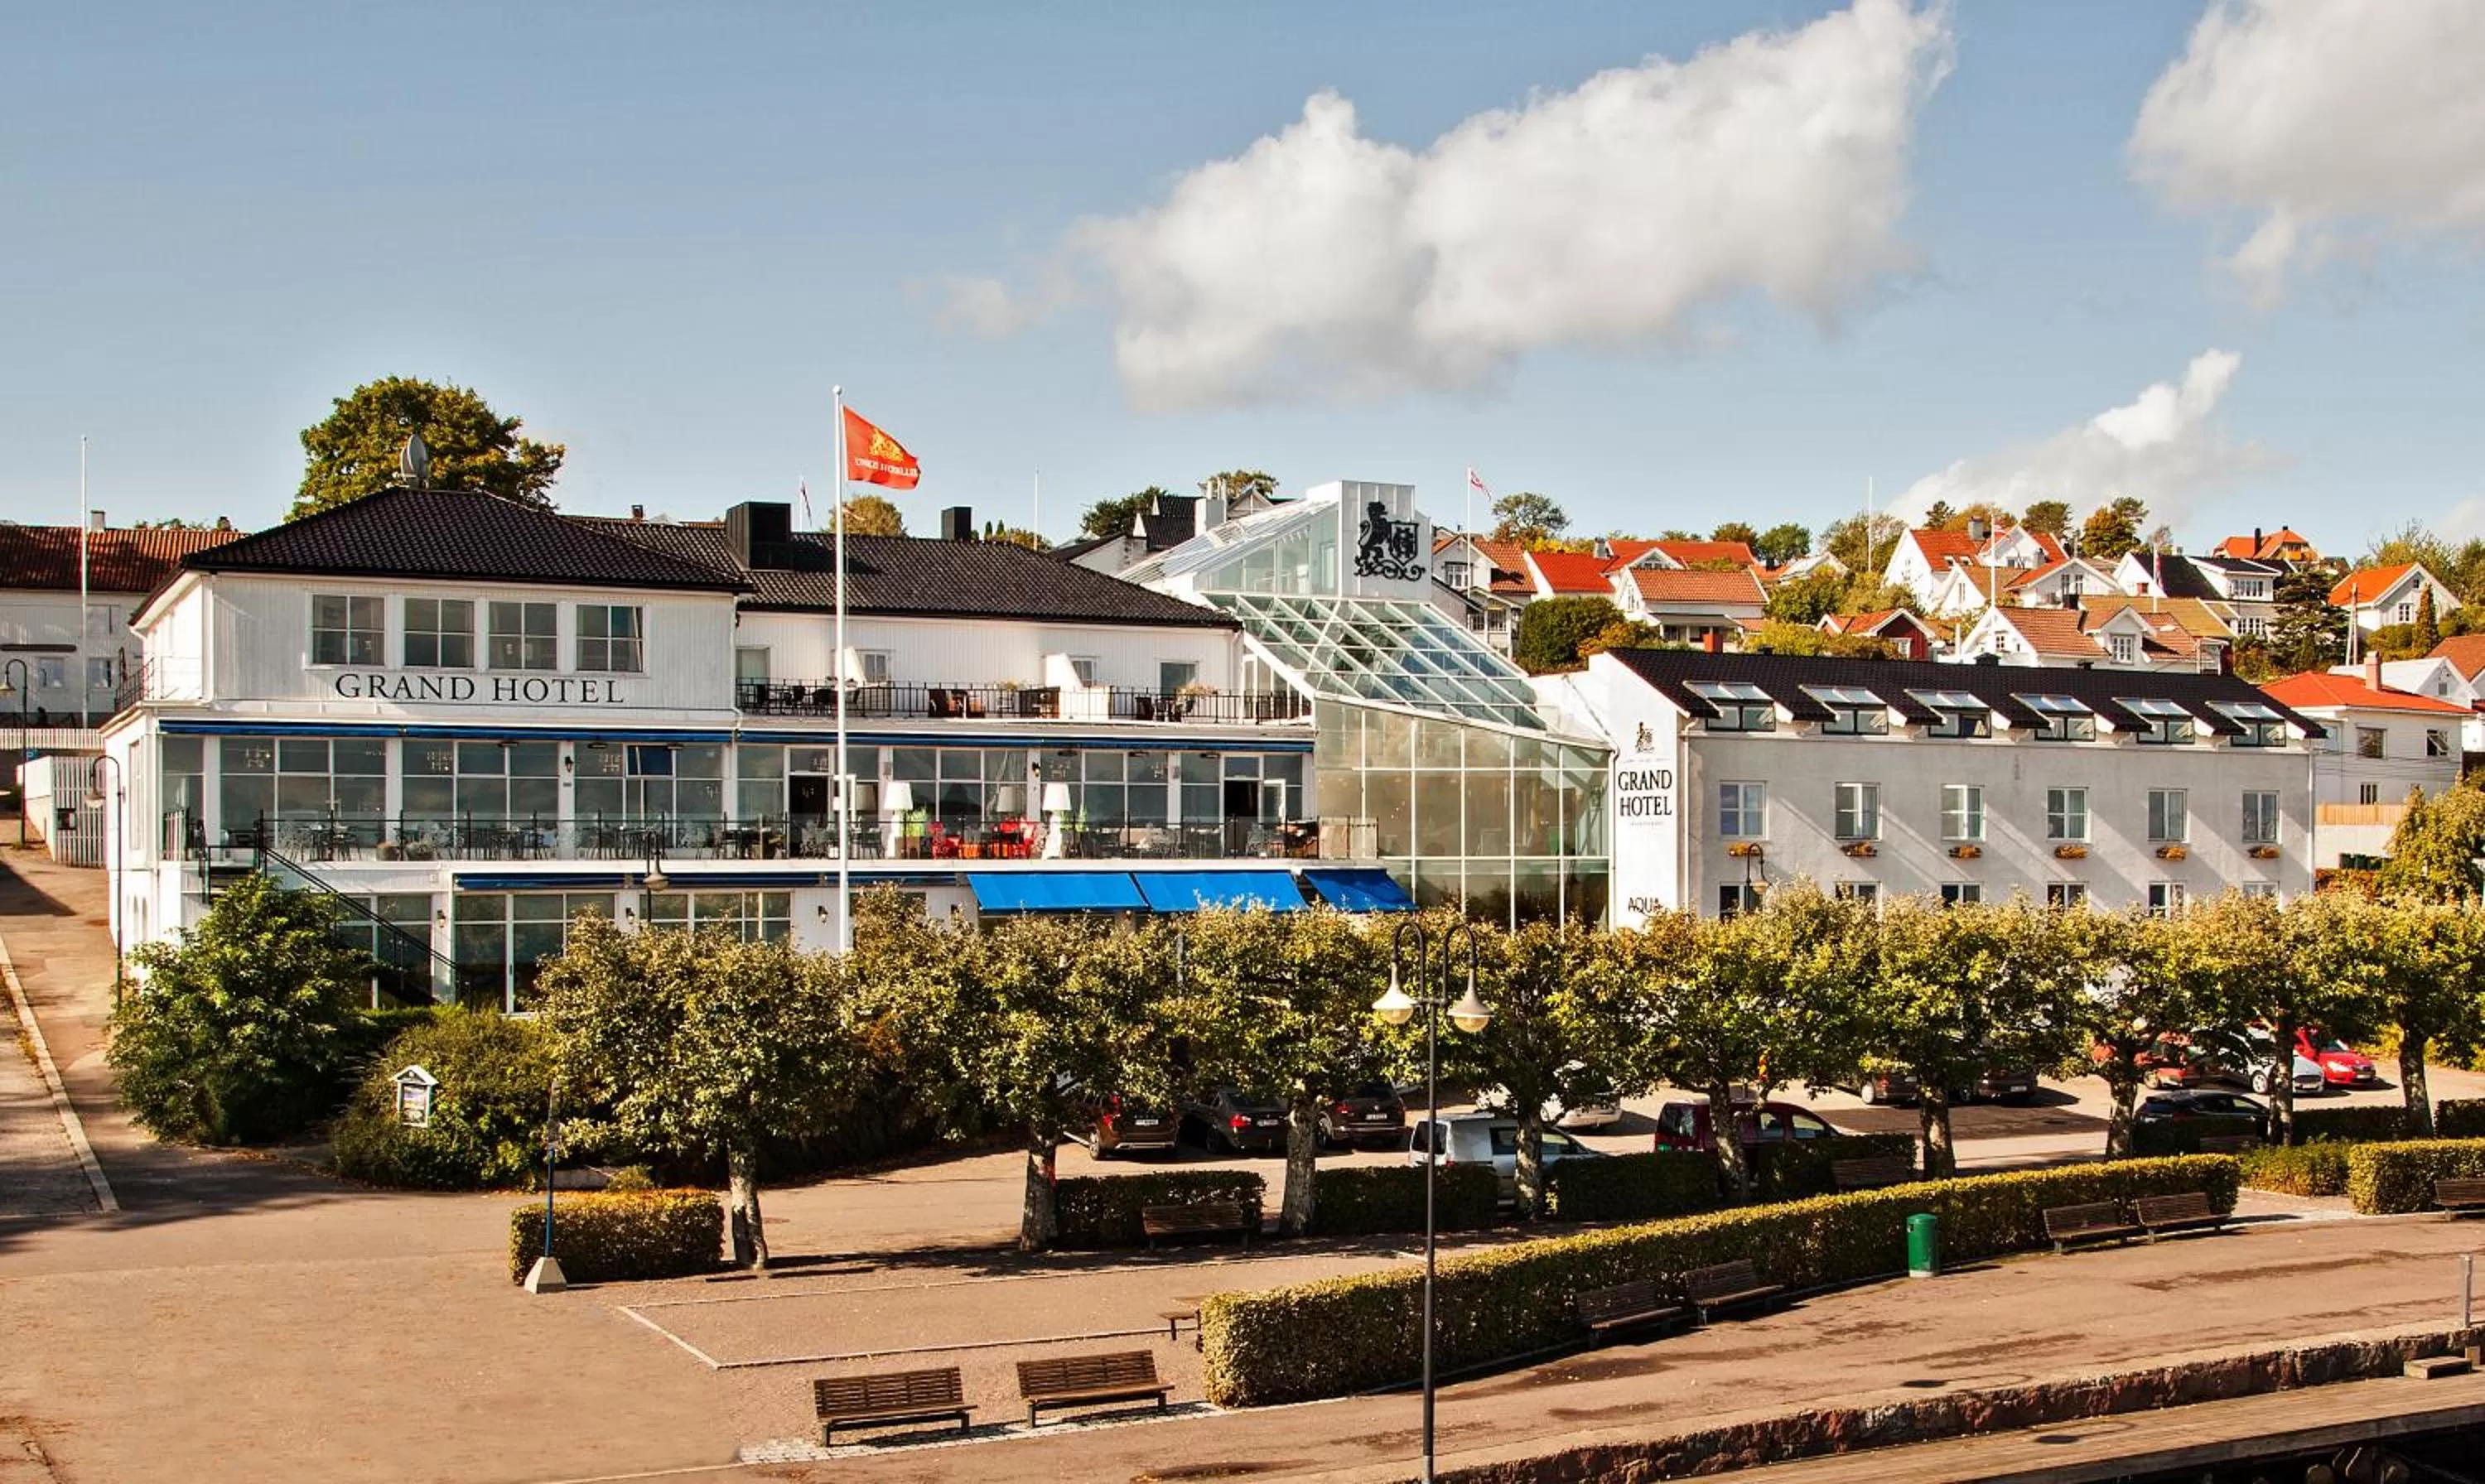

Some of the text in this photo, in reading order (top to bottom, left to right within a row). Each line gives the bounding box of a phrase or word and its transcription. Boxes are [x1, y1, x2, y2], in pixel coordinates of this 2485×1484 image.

[335, 673, 624, 703] GRAND HOTEL
[1618, 769, 1672, 791] GRAND
[1620, 796, 1672, 817] HOTEL
